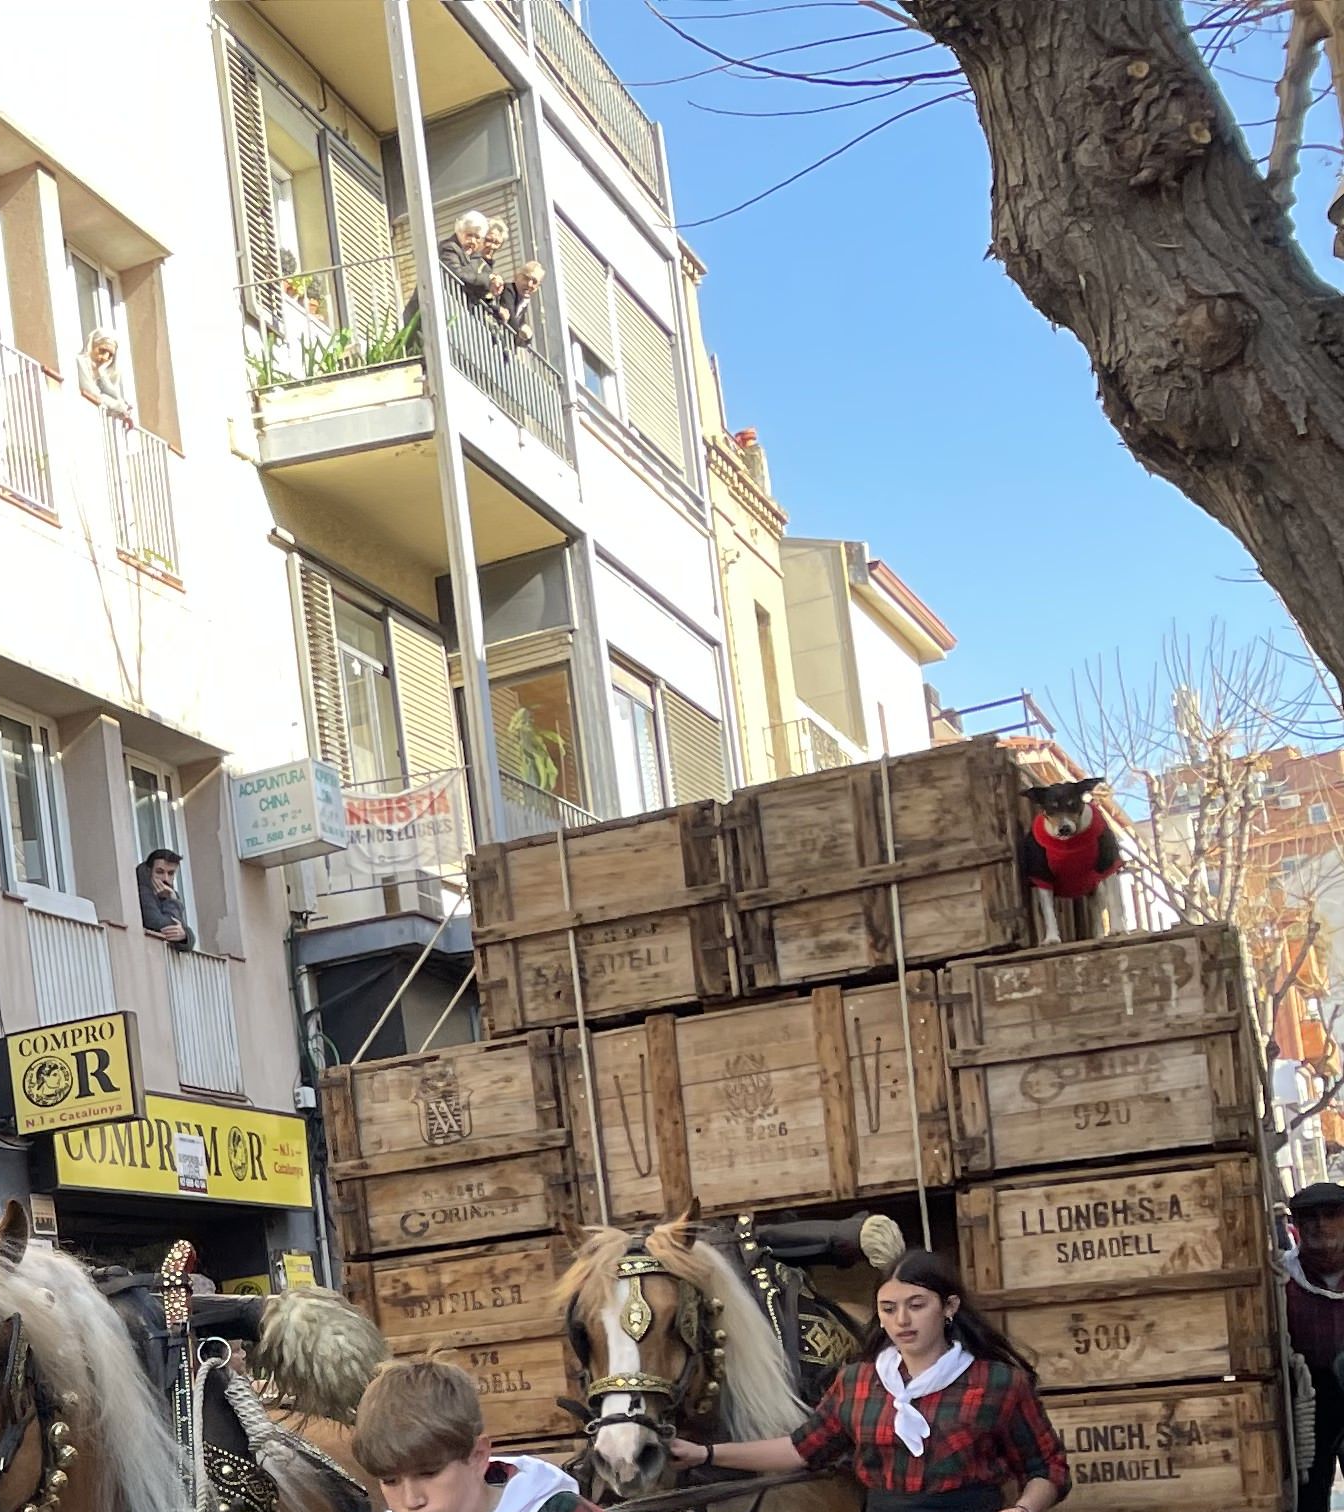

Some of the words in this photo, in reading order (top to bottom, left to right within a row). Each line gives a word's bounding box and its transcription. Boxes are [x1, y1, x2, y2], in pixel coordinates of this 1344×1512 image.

[238, 767, 306, 797] ACUPUNTURA
[259, 791, 290, 811] CHINA
[18, 1021, 115, 1057] COMPRO
[59, 1103, 123, 1122] Catalunya
[1073, 1100, 1130, 1130] 920
[1056, 1233, 1161, 1264] SABADELL
[478, 1370, 532, 1396] DELL
[1076, 1456, 1181, 1484] SABADELL
